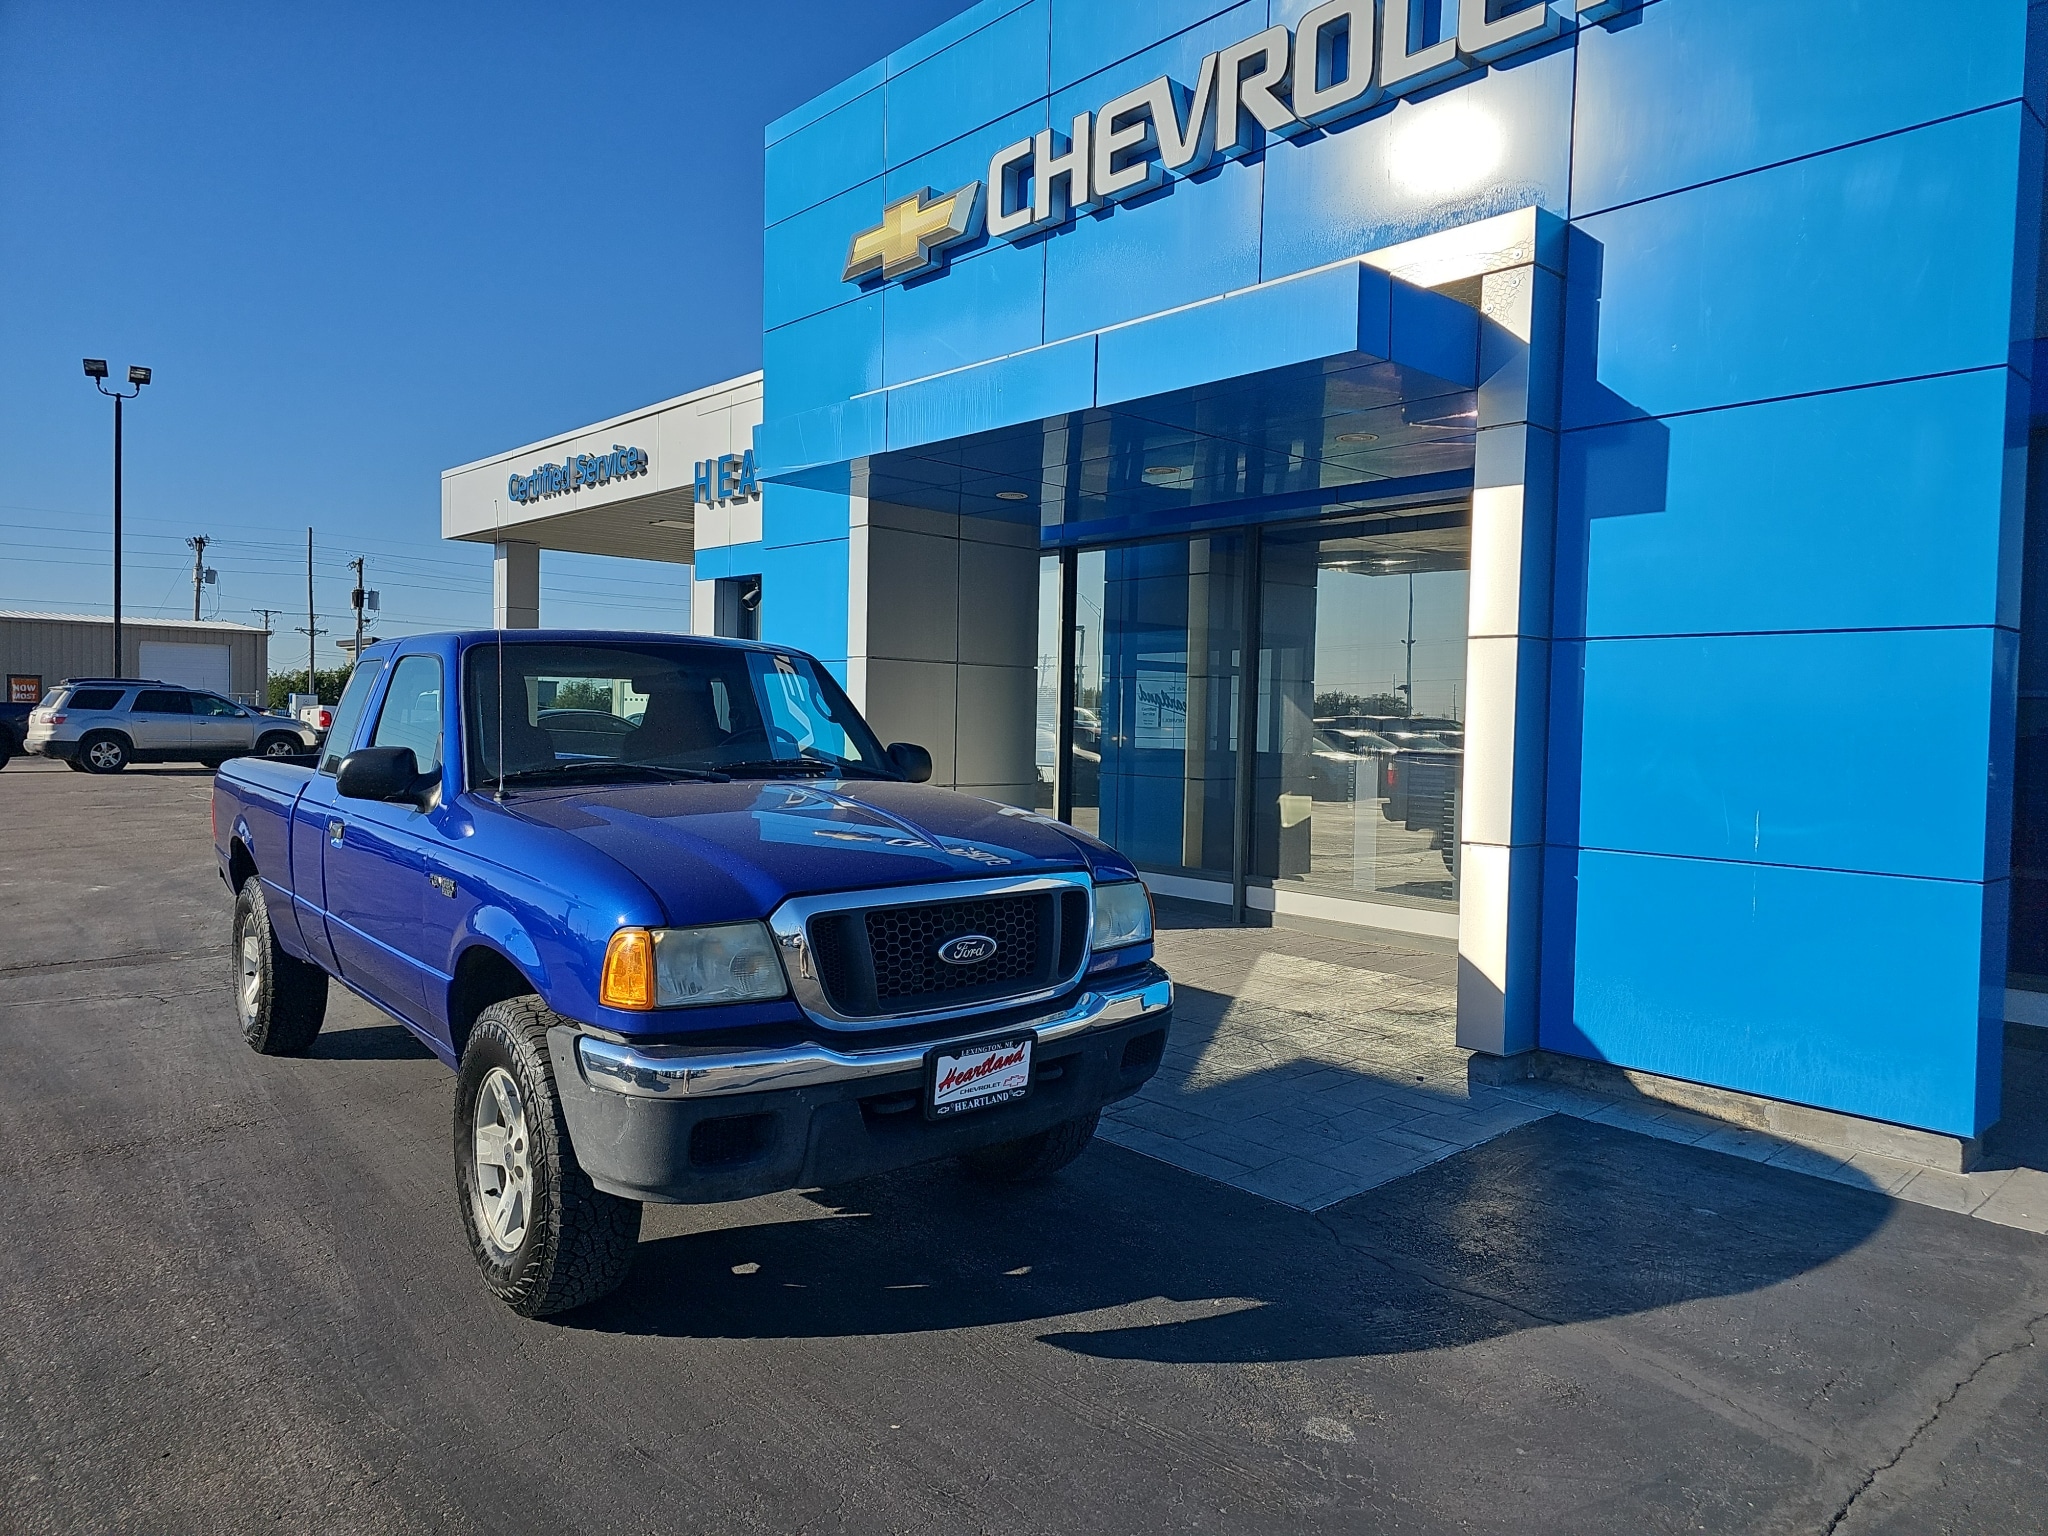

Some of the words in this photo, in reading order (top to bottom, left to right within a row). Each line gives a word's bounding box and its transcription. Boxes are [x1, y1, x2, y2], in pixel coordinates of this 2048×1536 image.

[985, 0, 1607, 238] CHEVROL
[508, 456, 570, 502] Certified
[575, 443, 638, 485] Service
[953, 940, 985, 959] Ford
[938, 1041, 1026, 1092] Heartland
[954, 1091, 1009, 1112] HEARTLAND
[959, 1081, 1002, 1095] CHEVROLET
